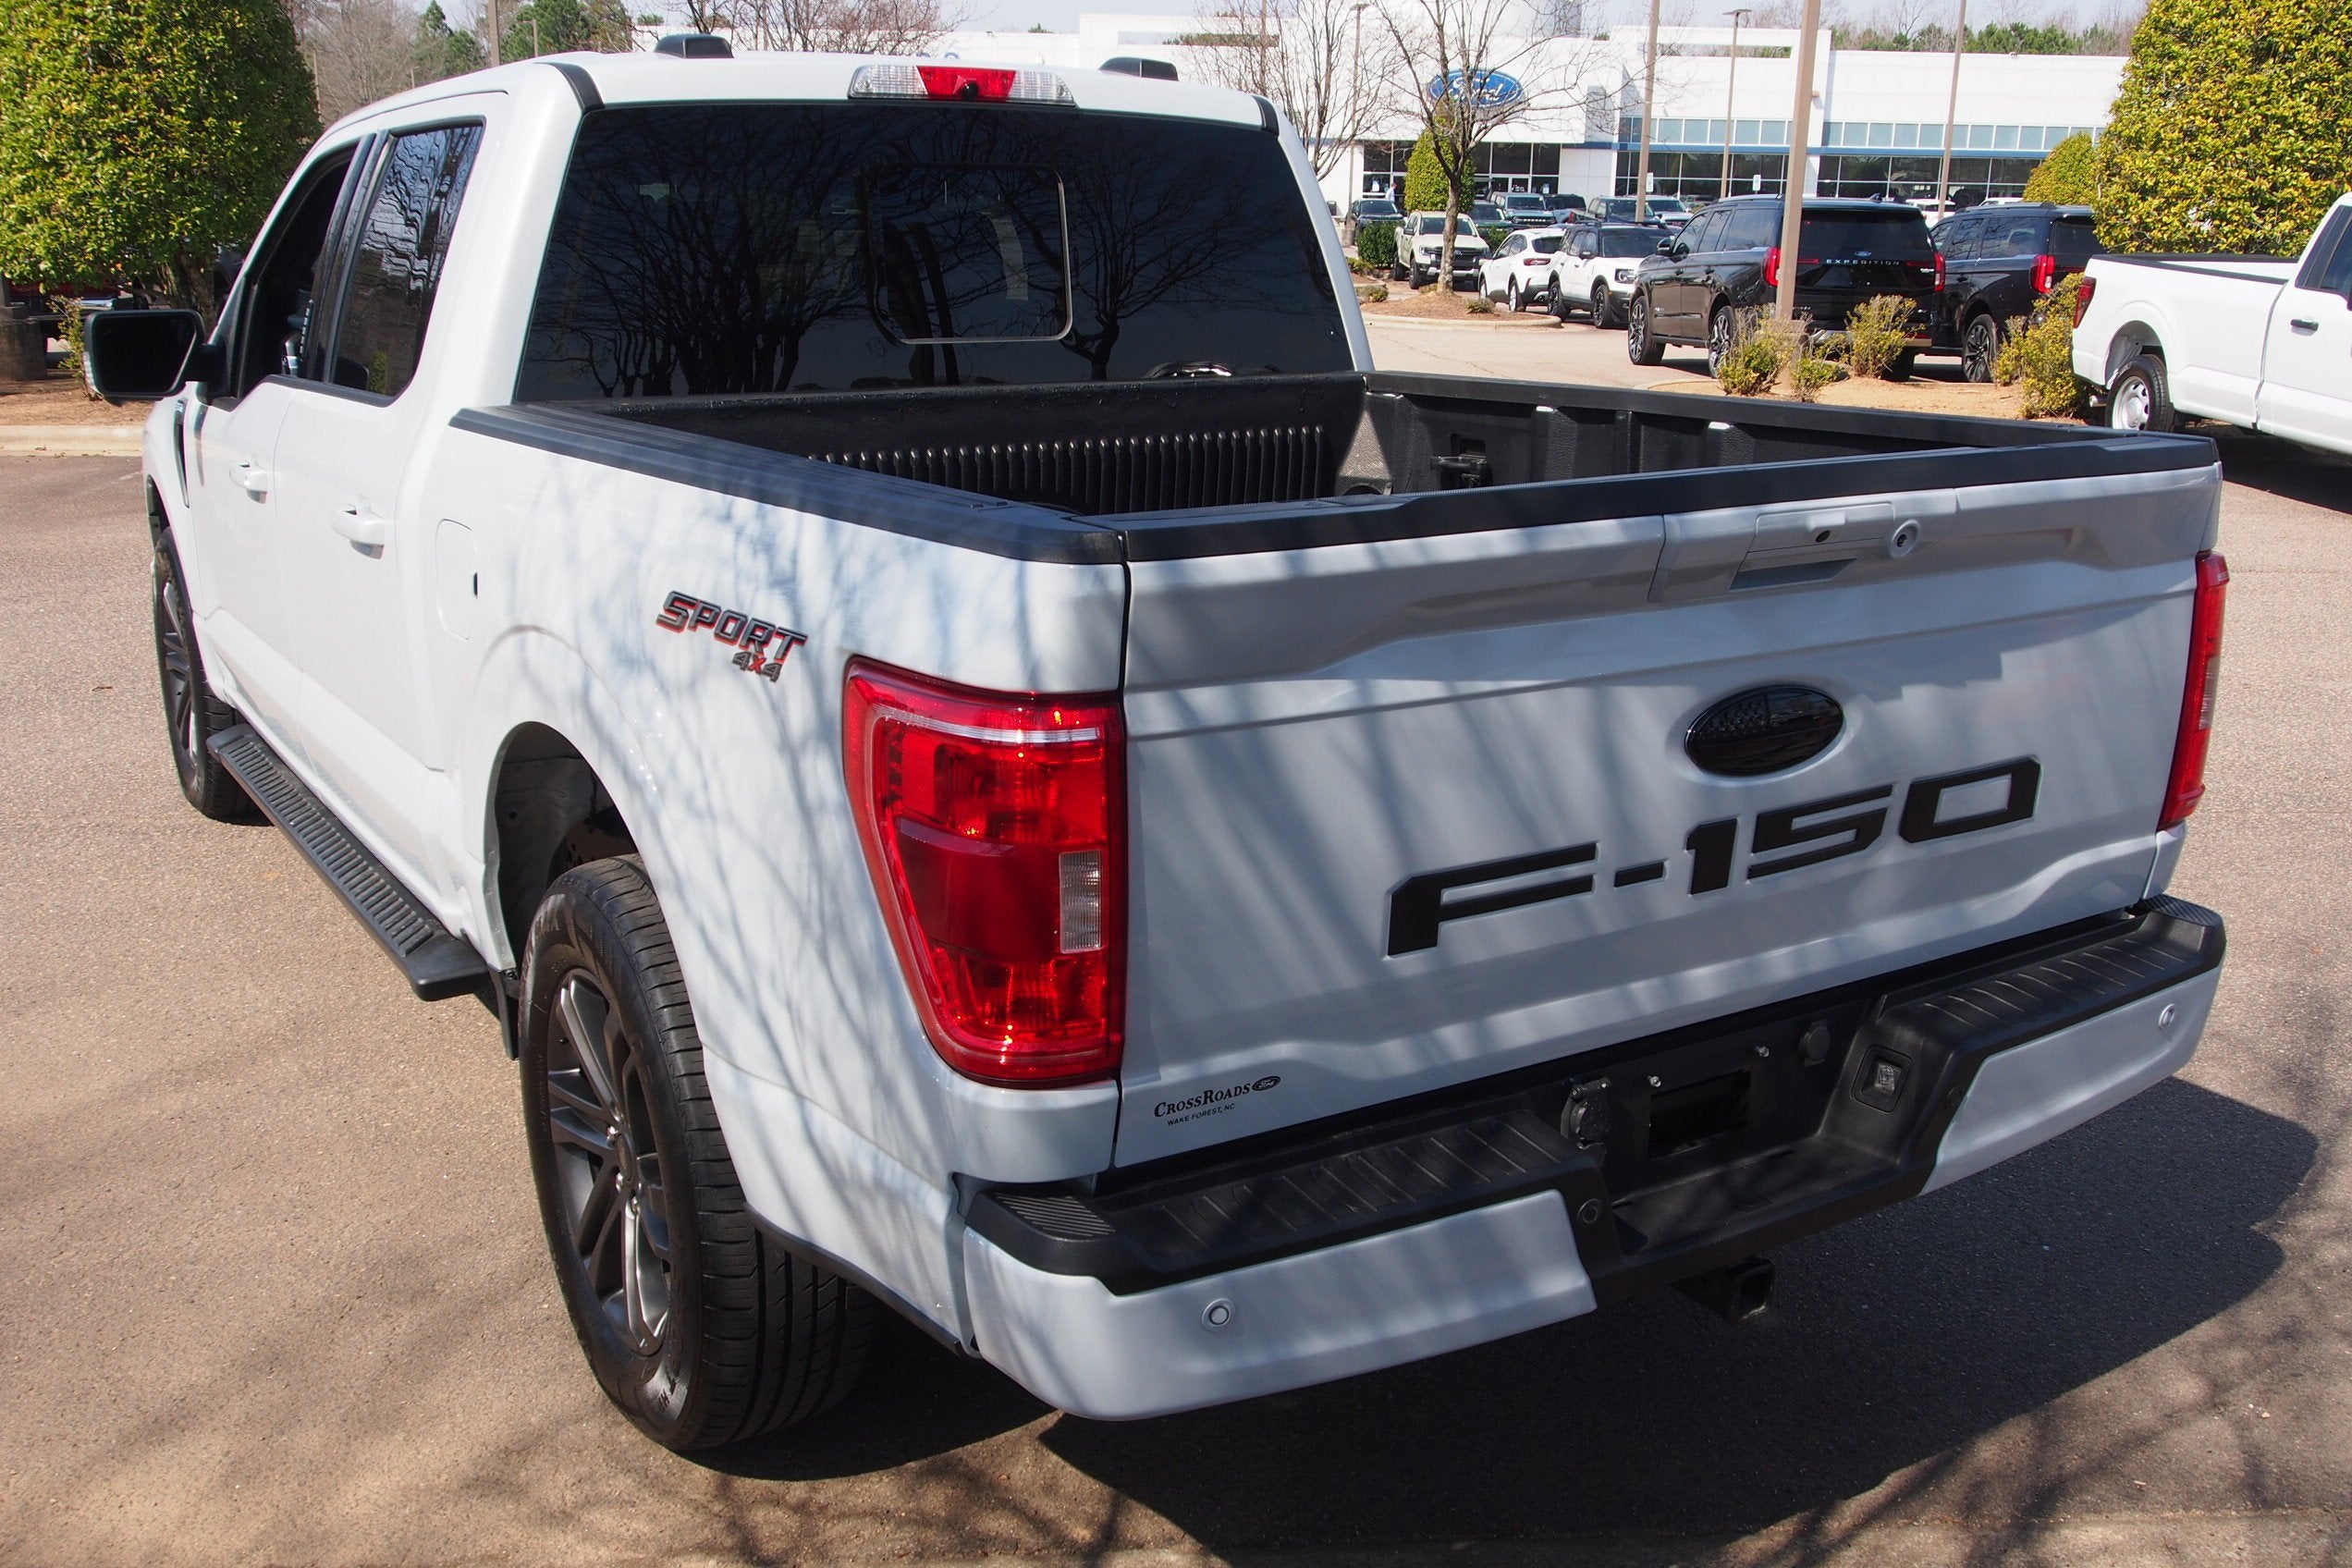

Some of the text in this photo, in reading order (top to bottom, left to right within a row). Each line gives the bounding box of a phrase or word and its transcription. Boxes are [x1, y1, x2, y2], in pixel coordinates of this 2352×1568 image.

[655, 591, 809, 664] SPORT
[1387, 756, 2040, 957] F-150
[1168, 1103, 1236, 1126] WAKE FOREST, NC
